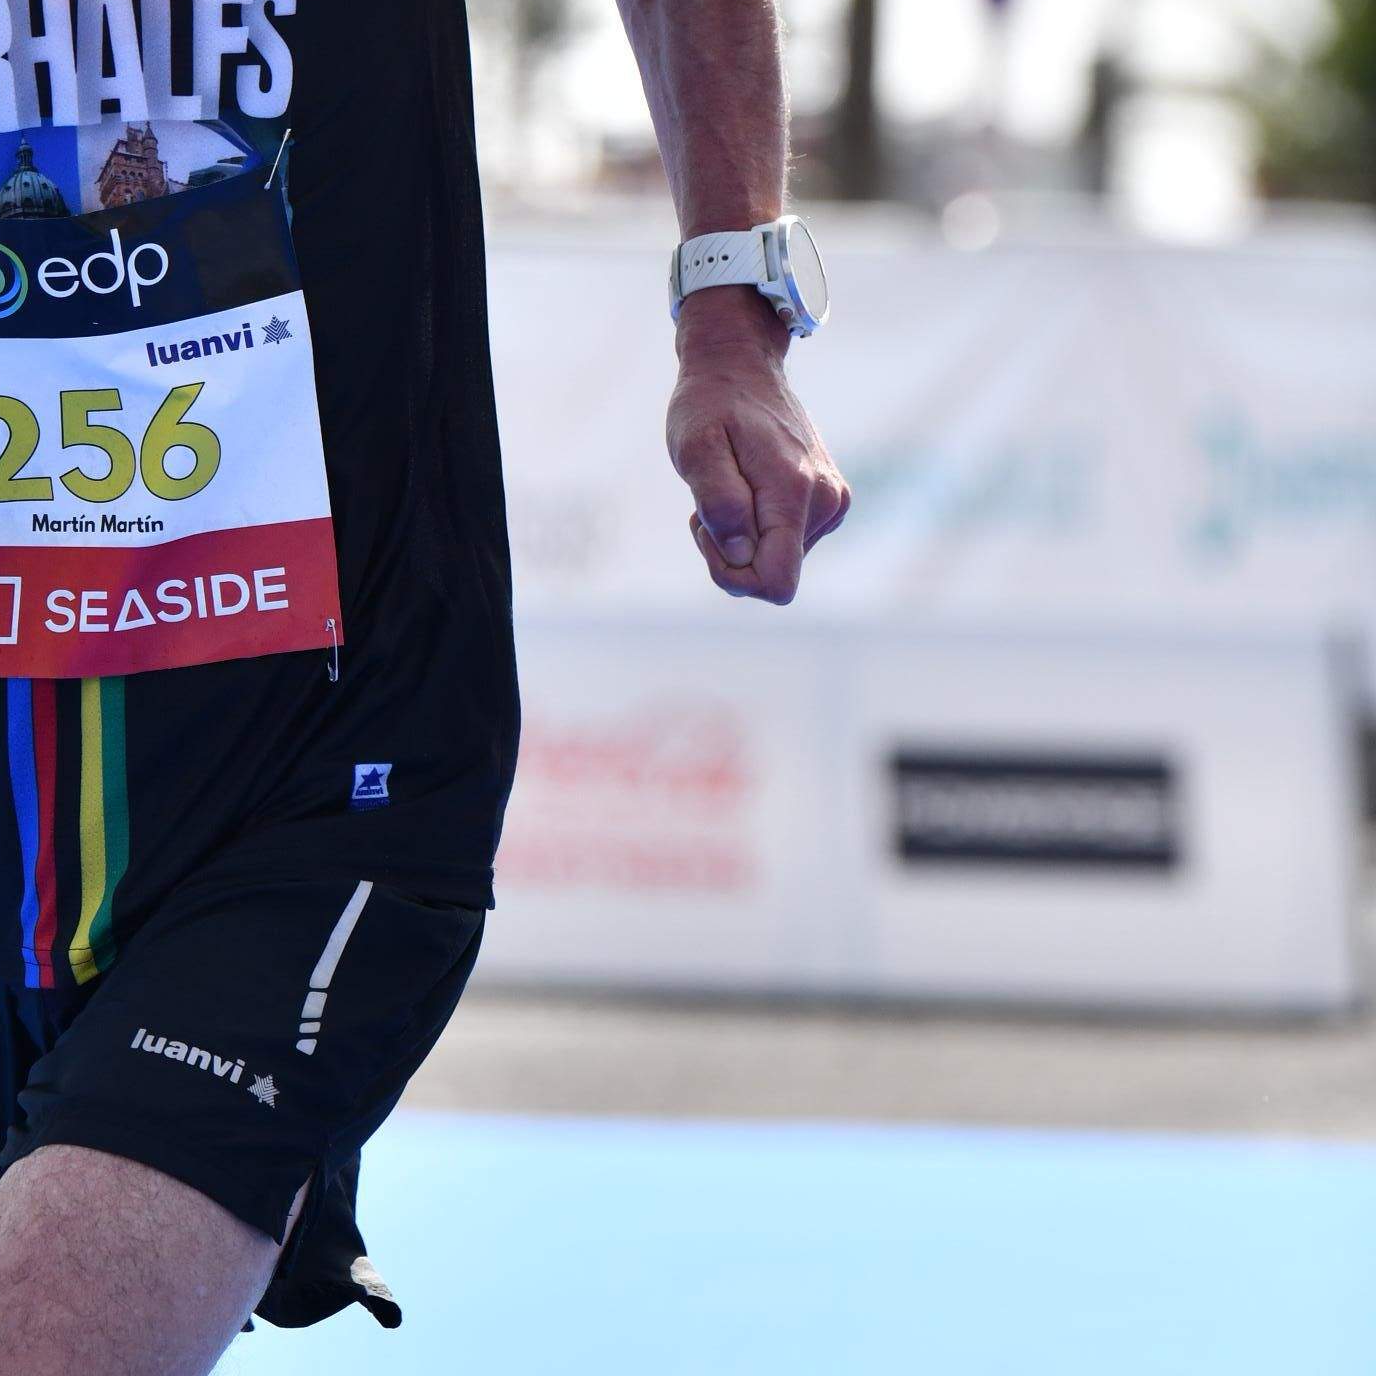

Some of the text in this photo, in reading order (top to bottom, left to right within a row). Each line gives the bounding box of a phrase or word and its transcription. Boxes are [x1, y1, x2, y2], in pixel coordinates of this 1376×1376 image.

[37, 228, 169, 308] edp
[145, 322, 255, 367] luanvi
[31, 513, 165, 533] Martín Martín
[44, 566, 290, 634] SEASIDE
[130, 1028, 246, 1085] luanvi
